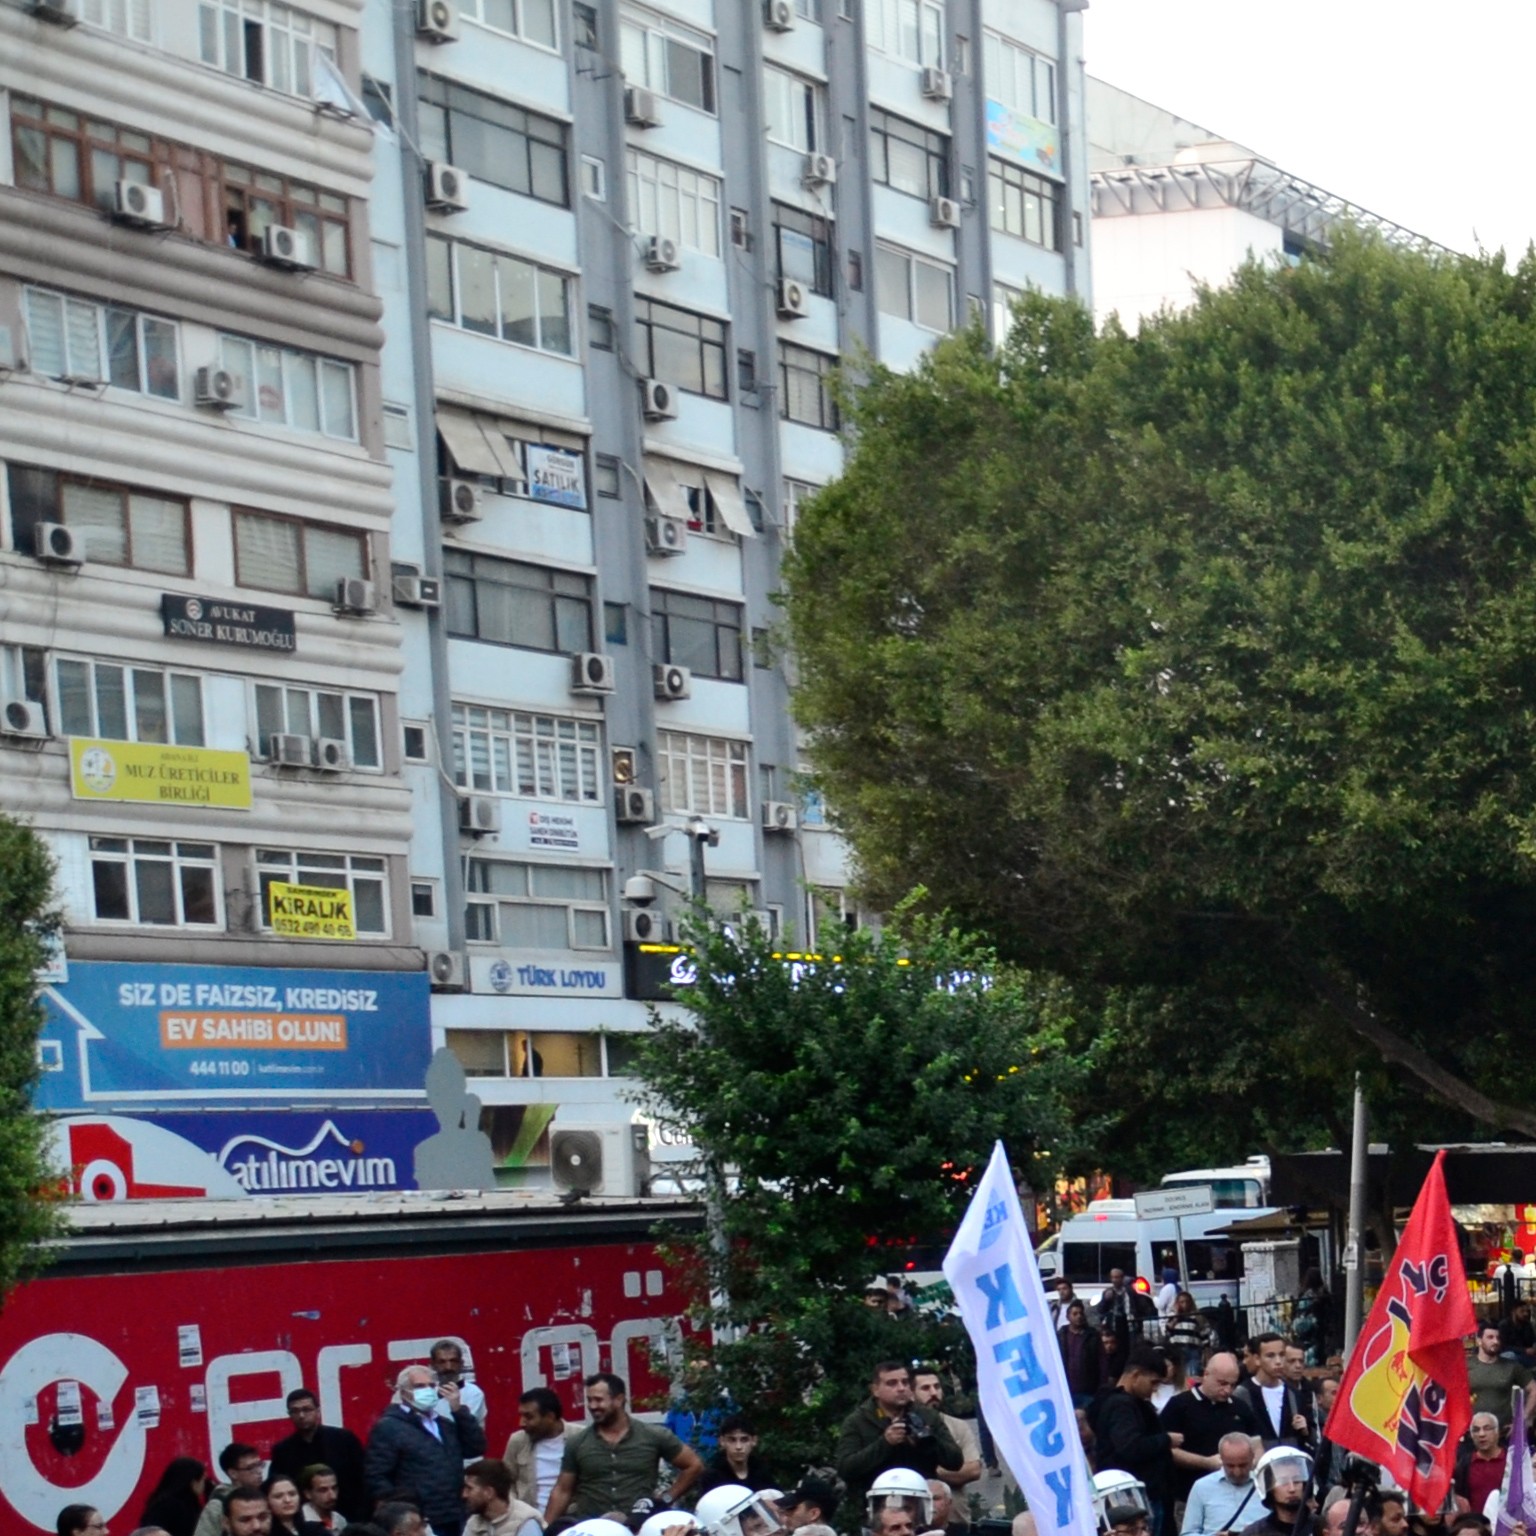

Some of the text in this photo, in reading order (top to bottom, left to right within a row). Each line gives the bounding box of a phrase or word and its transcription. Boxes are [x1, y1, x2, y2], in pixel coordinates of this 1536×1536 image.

[534, 469, 579, 493] SATILIK
[210, 605, 256, 623] AVUKAT
[170, 617, 294, 649] SONER KURUMOĞLU
[125, 762, 240, 785] MUZ ÜRETİCİLER
[159, 784, 211, 802] BİRLİĞİ
[273, 895, 349, 921] KİRALIK
[517, 963, 606, 989] TÜRK LOYDU
[119, 982, 156, 1006] SİZ
[160, 985, 192, 1007] DE
[286, 987, 378, 1012] KREDİSİZ
[167, 1018, 341, 1043] EV SAHİBİ OLUN!
[189, 1060, 218, 1076] 444
